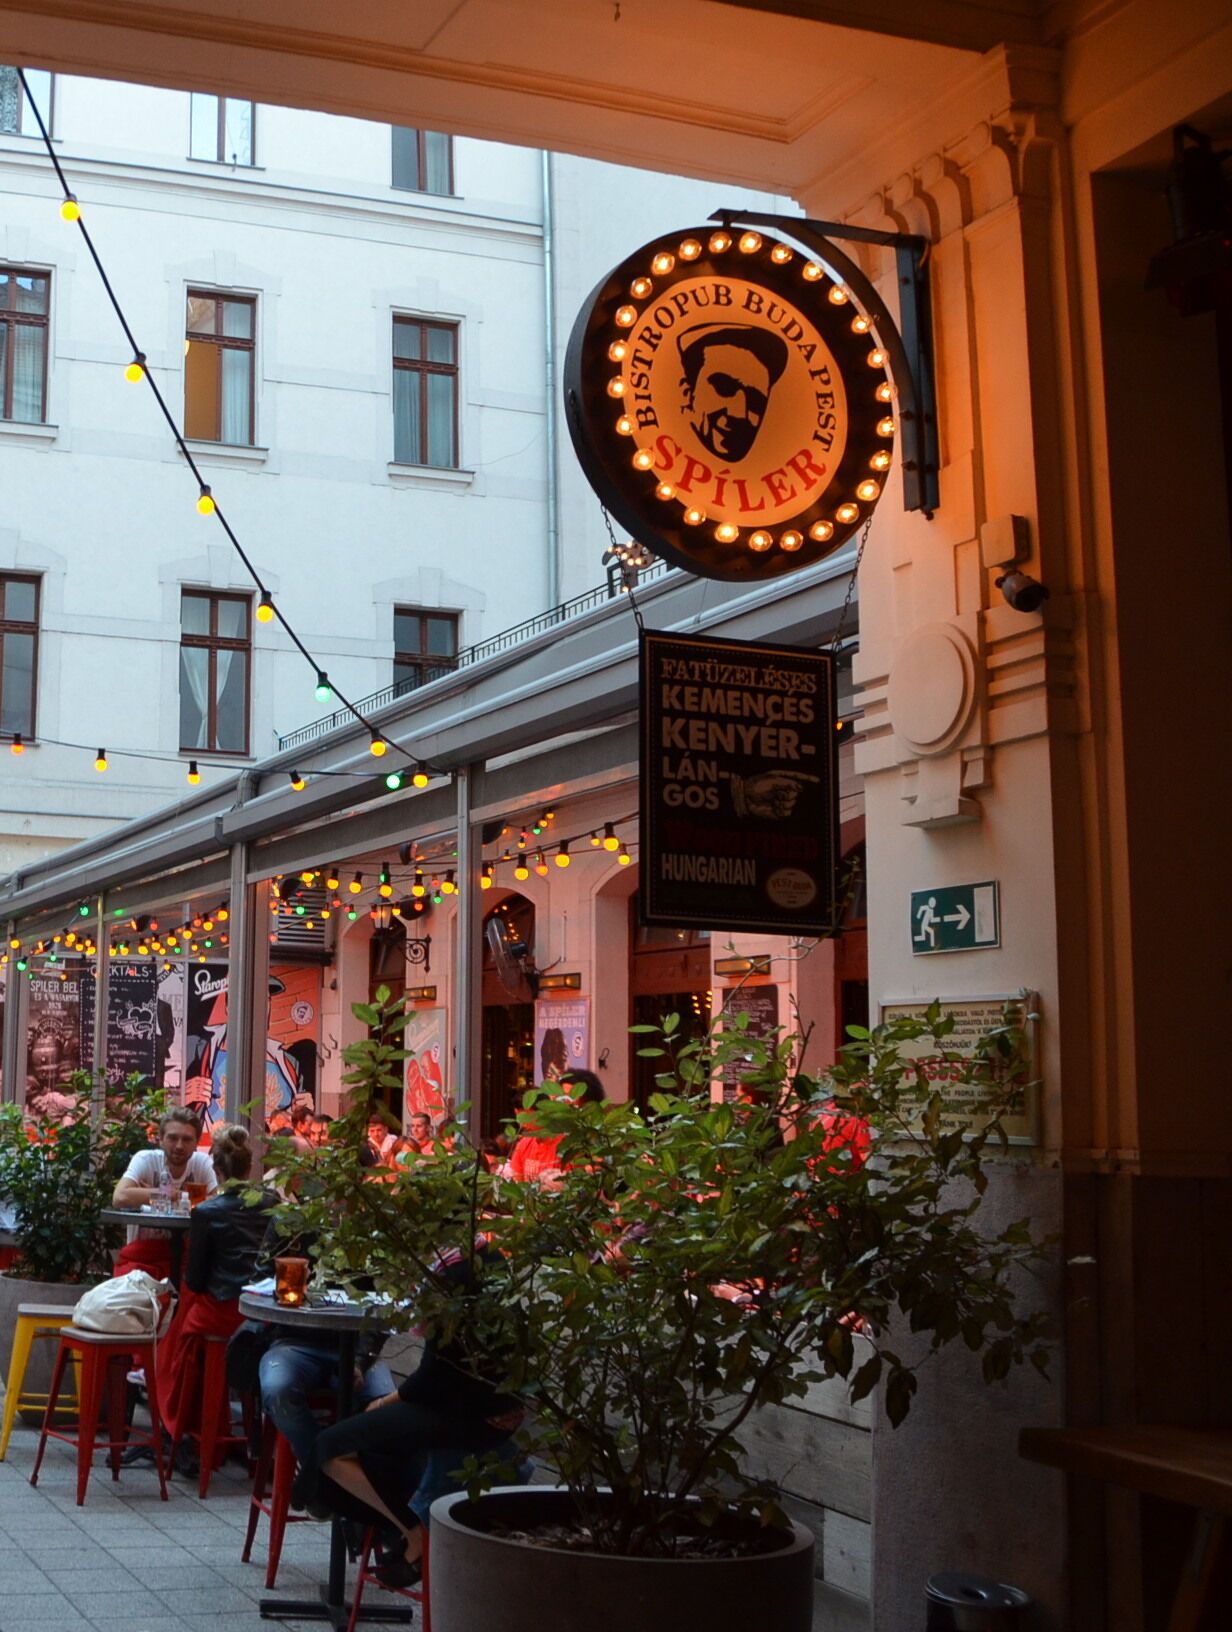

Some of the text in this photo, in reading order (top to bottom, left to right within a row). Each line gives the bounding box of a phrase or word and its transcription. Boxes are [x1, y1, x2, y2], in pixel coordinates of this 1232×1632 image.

[630, 283, 836, 453] BISTROPUB BUDAPEST
[652, 434, 828, 513] SPÍLER
[662, 784, 720, 811] GOS
[661, 853, 757, 886] HUNGARIAN
[194, 969, 229, 995] Starop
